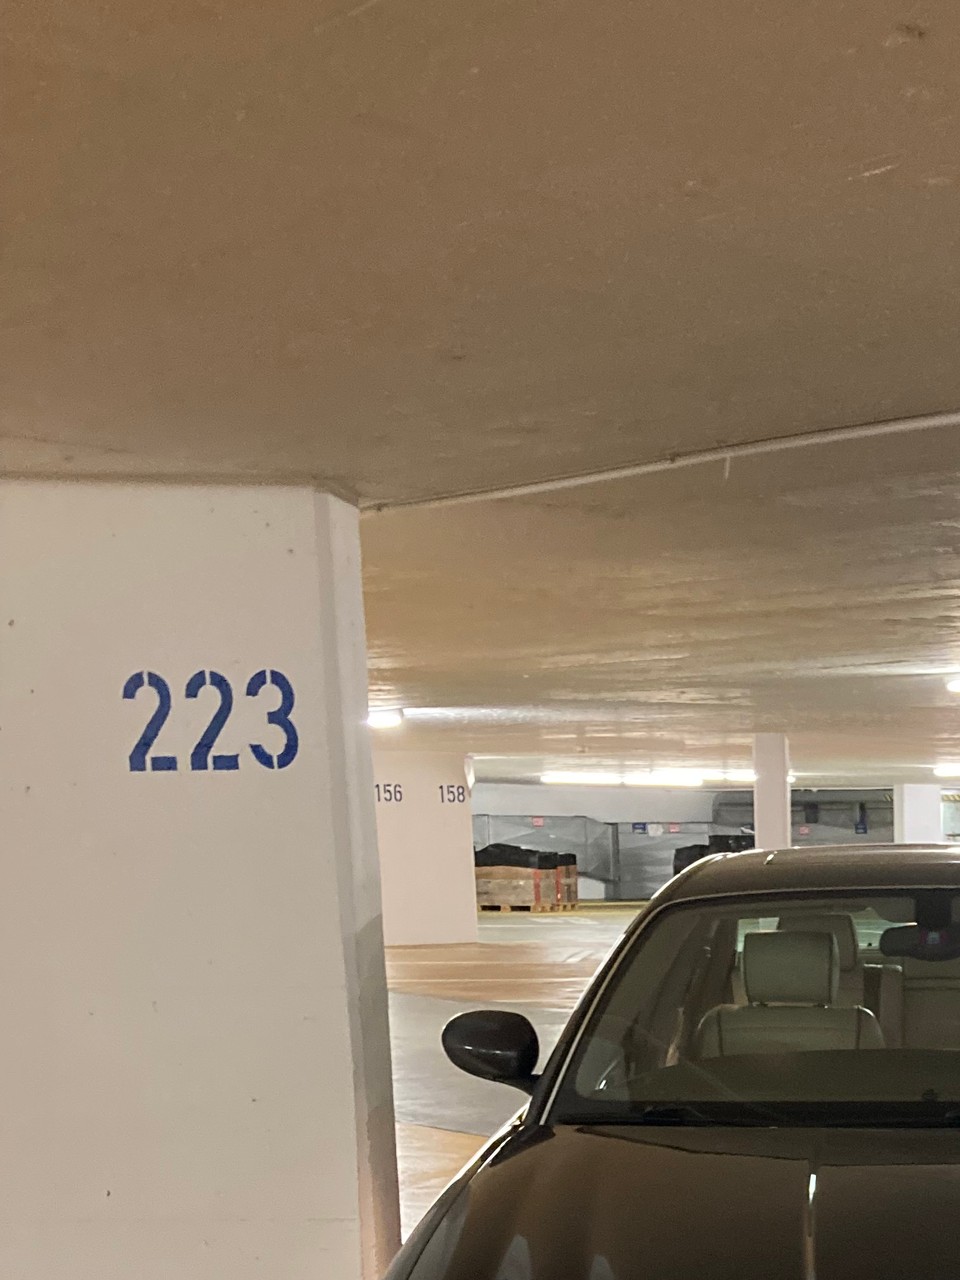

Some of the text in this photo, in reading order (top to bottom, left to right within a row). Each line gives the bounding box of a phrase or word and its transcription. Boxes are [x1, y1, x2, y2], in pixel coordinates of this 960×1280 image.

[122, 669, 299, 772] 223
[374, 783, 403, 803] 156
[438, 784, 466, 803] 158
